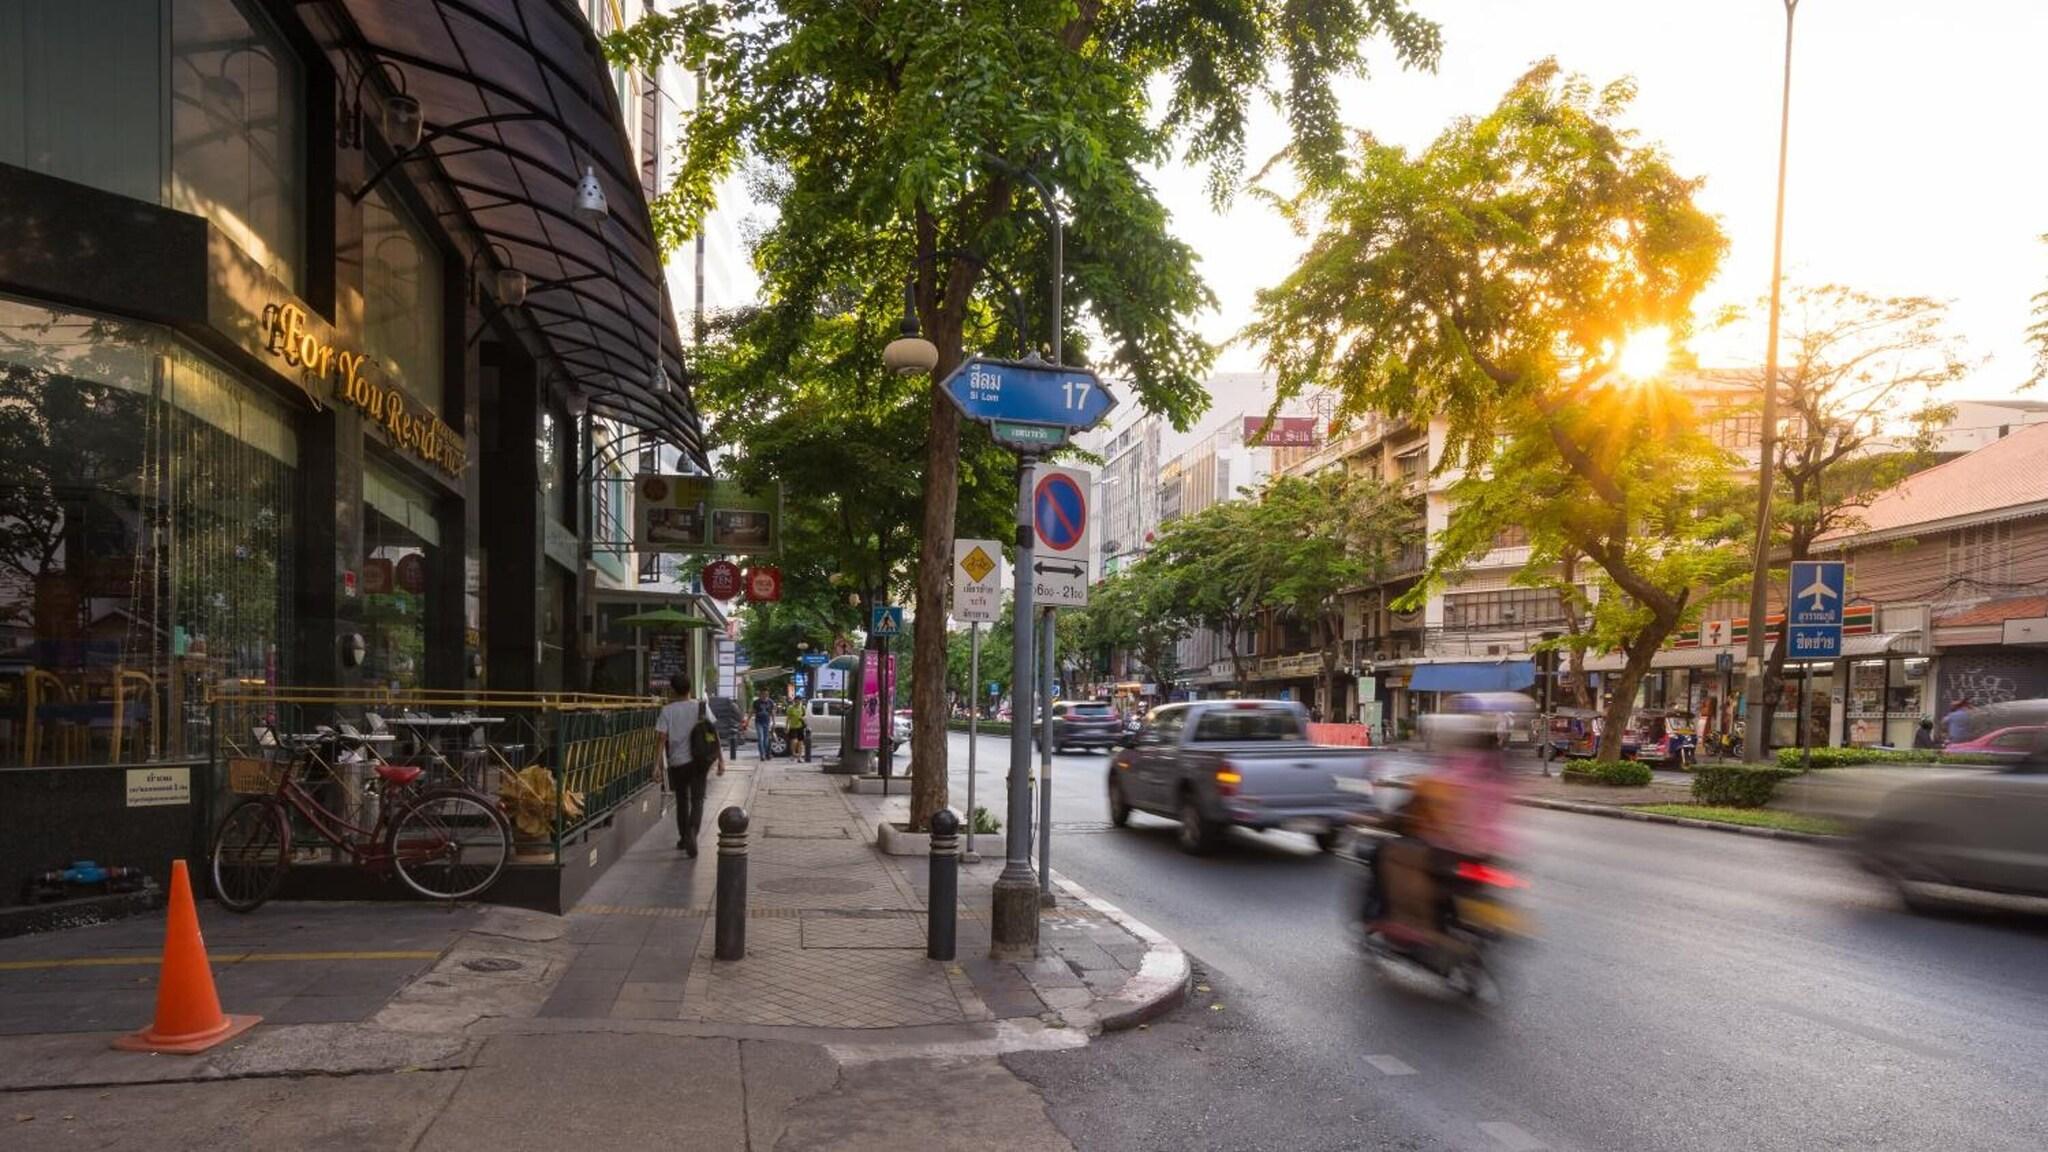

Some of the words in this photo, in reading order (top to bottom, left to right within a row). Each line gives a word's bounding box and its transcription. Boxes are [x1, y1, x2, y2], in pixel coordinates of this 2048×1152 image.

[264, 303, 333, 379] For
[338, 351, 384, 421] You
[969, 363, 1001, 391] สีลม
[970, 391, 978, 400] Si
[982, 393, 999, 402] Lom
[1061, 381, 1091, 411] 17
[712, 576, 733, 585] ZEN
[1796, 630, 1834, 649] ชิดซ้าย
